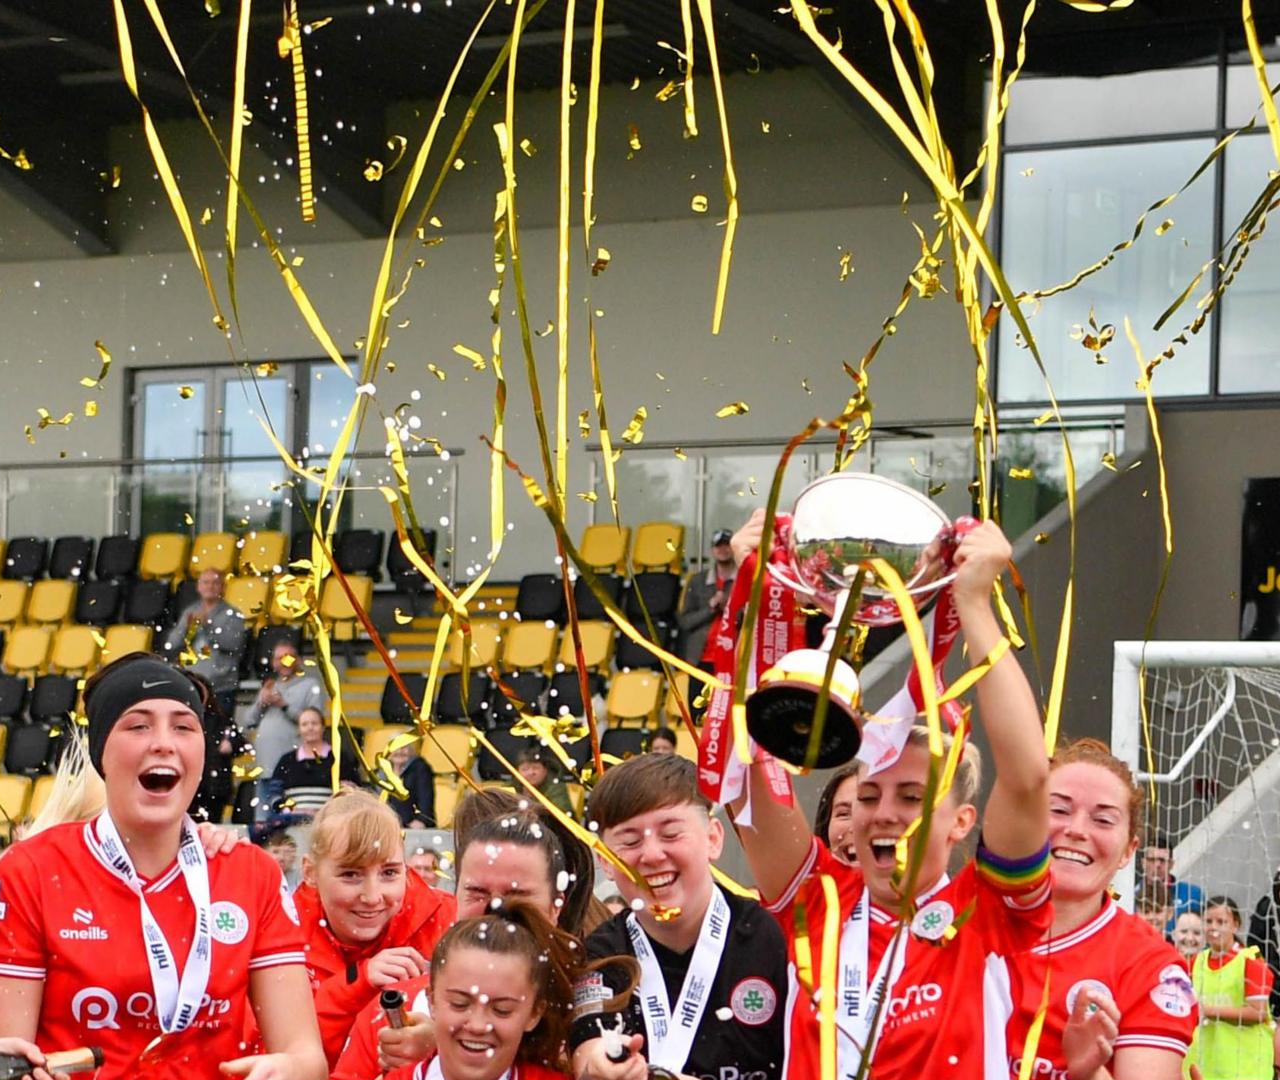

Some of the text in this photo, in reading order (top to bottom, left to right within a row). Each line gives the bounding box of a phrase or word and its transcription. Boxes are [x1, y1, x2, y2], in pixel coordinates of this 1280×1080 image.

[647, 995, 665, 1018] nifl
[681, 1001, 700, 1028] nifl
[844, 990, 860, 1017] nifl
